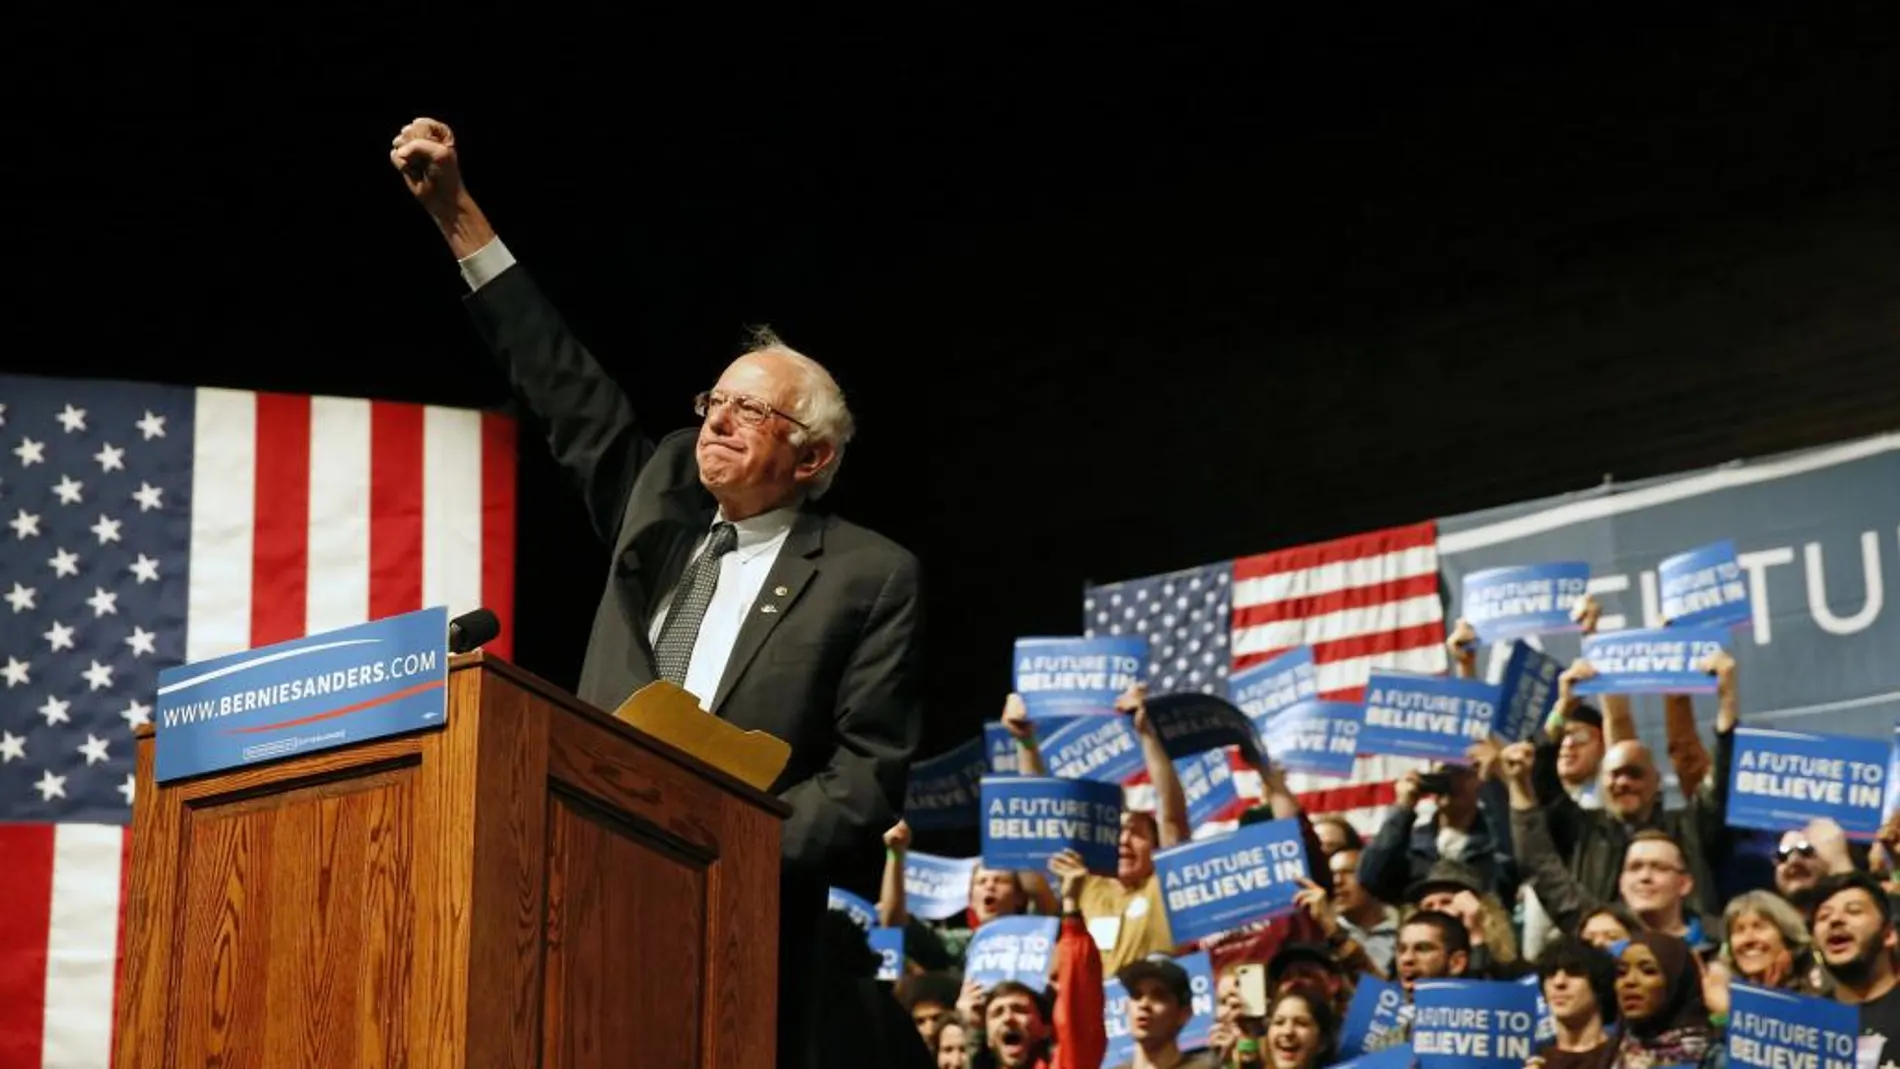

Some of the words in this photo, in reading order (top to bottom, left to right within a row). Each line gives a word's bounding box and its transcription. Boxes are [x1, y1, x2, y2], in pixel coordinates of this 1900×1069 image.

[1557, 578, 1584, 593] TO
[1606, 641, 1686, 657] FUTURE
[1018, 658, 1032, 671] A
[1034, 656, 1106, 672] FUTURE
[1112, 656, 1138, 673] TO
[163, 650, 436, 729] WWW.BERNIESANDERS.COM
[1017, 673, 1106, 692] BELIEVE
[1370, 688, 1383, 703] A
[1385, 689, 1459, 716] FUTURE
[1465, 699, 1493, 720] TO
[1333, 719, 1360, 737] TO
[1365, 706, 1460, 736] BELIEVE
[1461, 717, 1490, 739] IN
[1060, 719, 1123, 761] FUTURE
[1329, 736, 1356, 755] IN
[1739, 750, 1756, 769] A
[1757, 751, 1845, 781] FUTURE
[1849, 761, 1883, 785] TO
[1735, 770, 1844, 804] BELIEVE
[1848, 784, 1882, 808] IN
[989, 798, 1005, 816] A
[1009, 798, 1089, 818] FUTURE
[1095, 803, 1119, 823] TO
[989, 818, 1091, 842] BELIEVE
[1095, 825, 1120, 845] IN
[1166, 870, 1182, 889] A
[1182, 846, 1265, 883] FUTURE
[1266, 840, 1299, 861] TO
[1167, 866, 1272, 912] BELIEVE
[1273, 859, 1304, 883] IN
[1374, 988, 1399, 1017] TO
[1494, 1009, 1531, 1032] TO
[1731, 1010, 1745, 1030] A
[1744, 1013, 1819, 1049] FUTURE
[1822, 1030, 1853, 1057] TO
[1496, 1035, 1530, 1059] IN
[1729, 1033, 1818, 1069] BELIEVE
